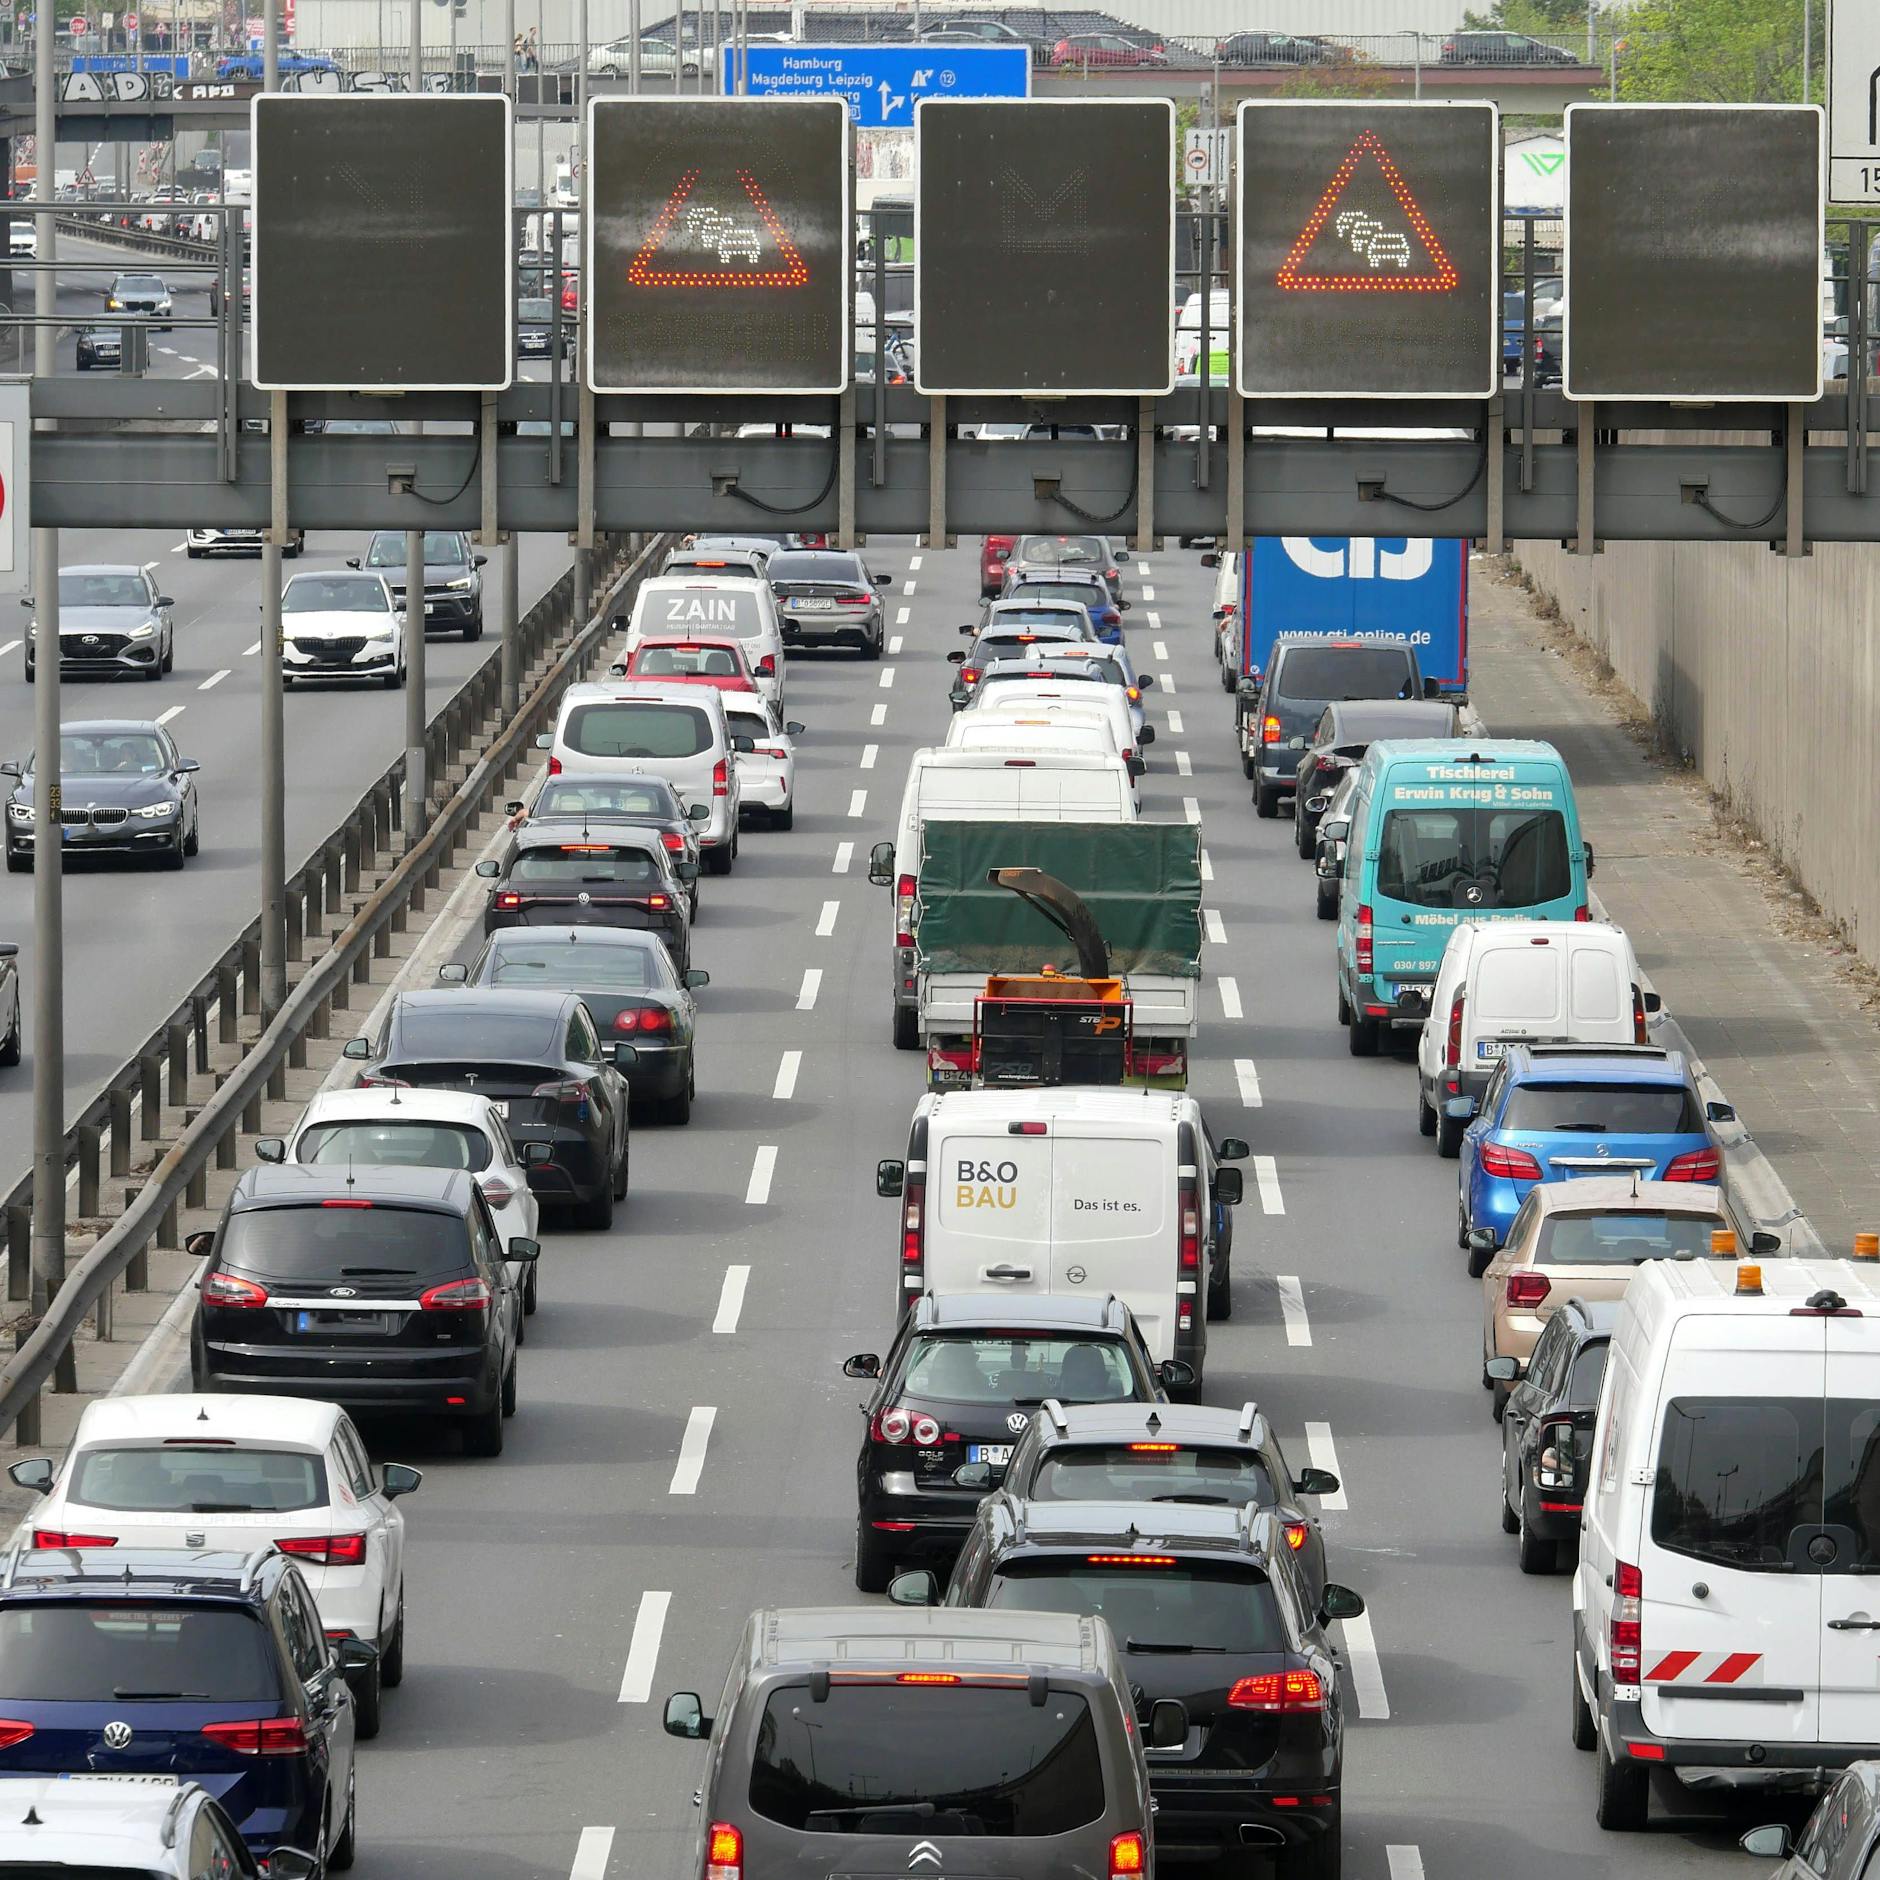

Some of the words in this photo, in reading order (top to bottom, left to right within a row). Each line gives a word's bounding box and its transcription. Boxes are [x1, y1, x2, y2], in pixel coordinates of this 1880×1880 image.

[783, 56, 842, 71] Hamburg
[752, 73, 823, 88] Magdeburg
[828, 73, 873, 88] Leipzig
[942, 73, 953, 84] 12
[667, 599, 736, 621] ZAIN
[1427, 766, 1515, 779] Tischlerei
[1394, 787, 1444, 800] Erwin
[1450, 787, 1492, 802] Krug
[1495, 784, 1507, 800] &
[1511, 787, 1552, 800] Sohn
[1415, 913, 1458, 925] Möbel
[1463, 916, 1487, 924] aus
[1418, 961, 1437, 970] 897
[957, 1160, 1018, 1183] B&O
[956, 1185, 1016, 1209] BAU
[1074, 1199, 1098, 1210] Das
[1103, 1199, 1119, 1211] ist
[1123, 1202, 1141, 1212] es.
